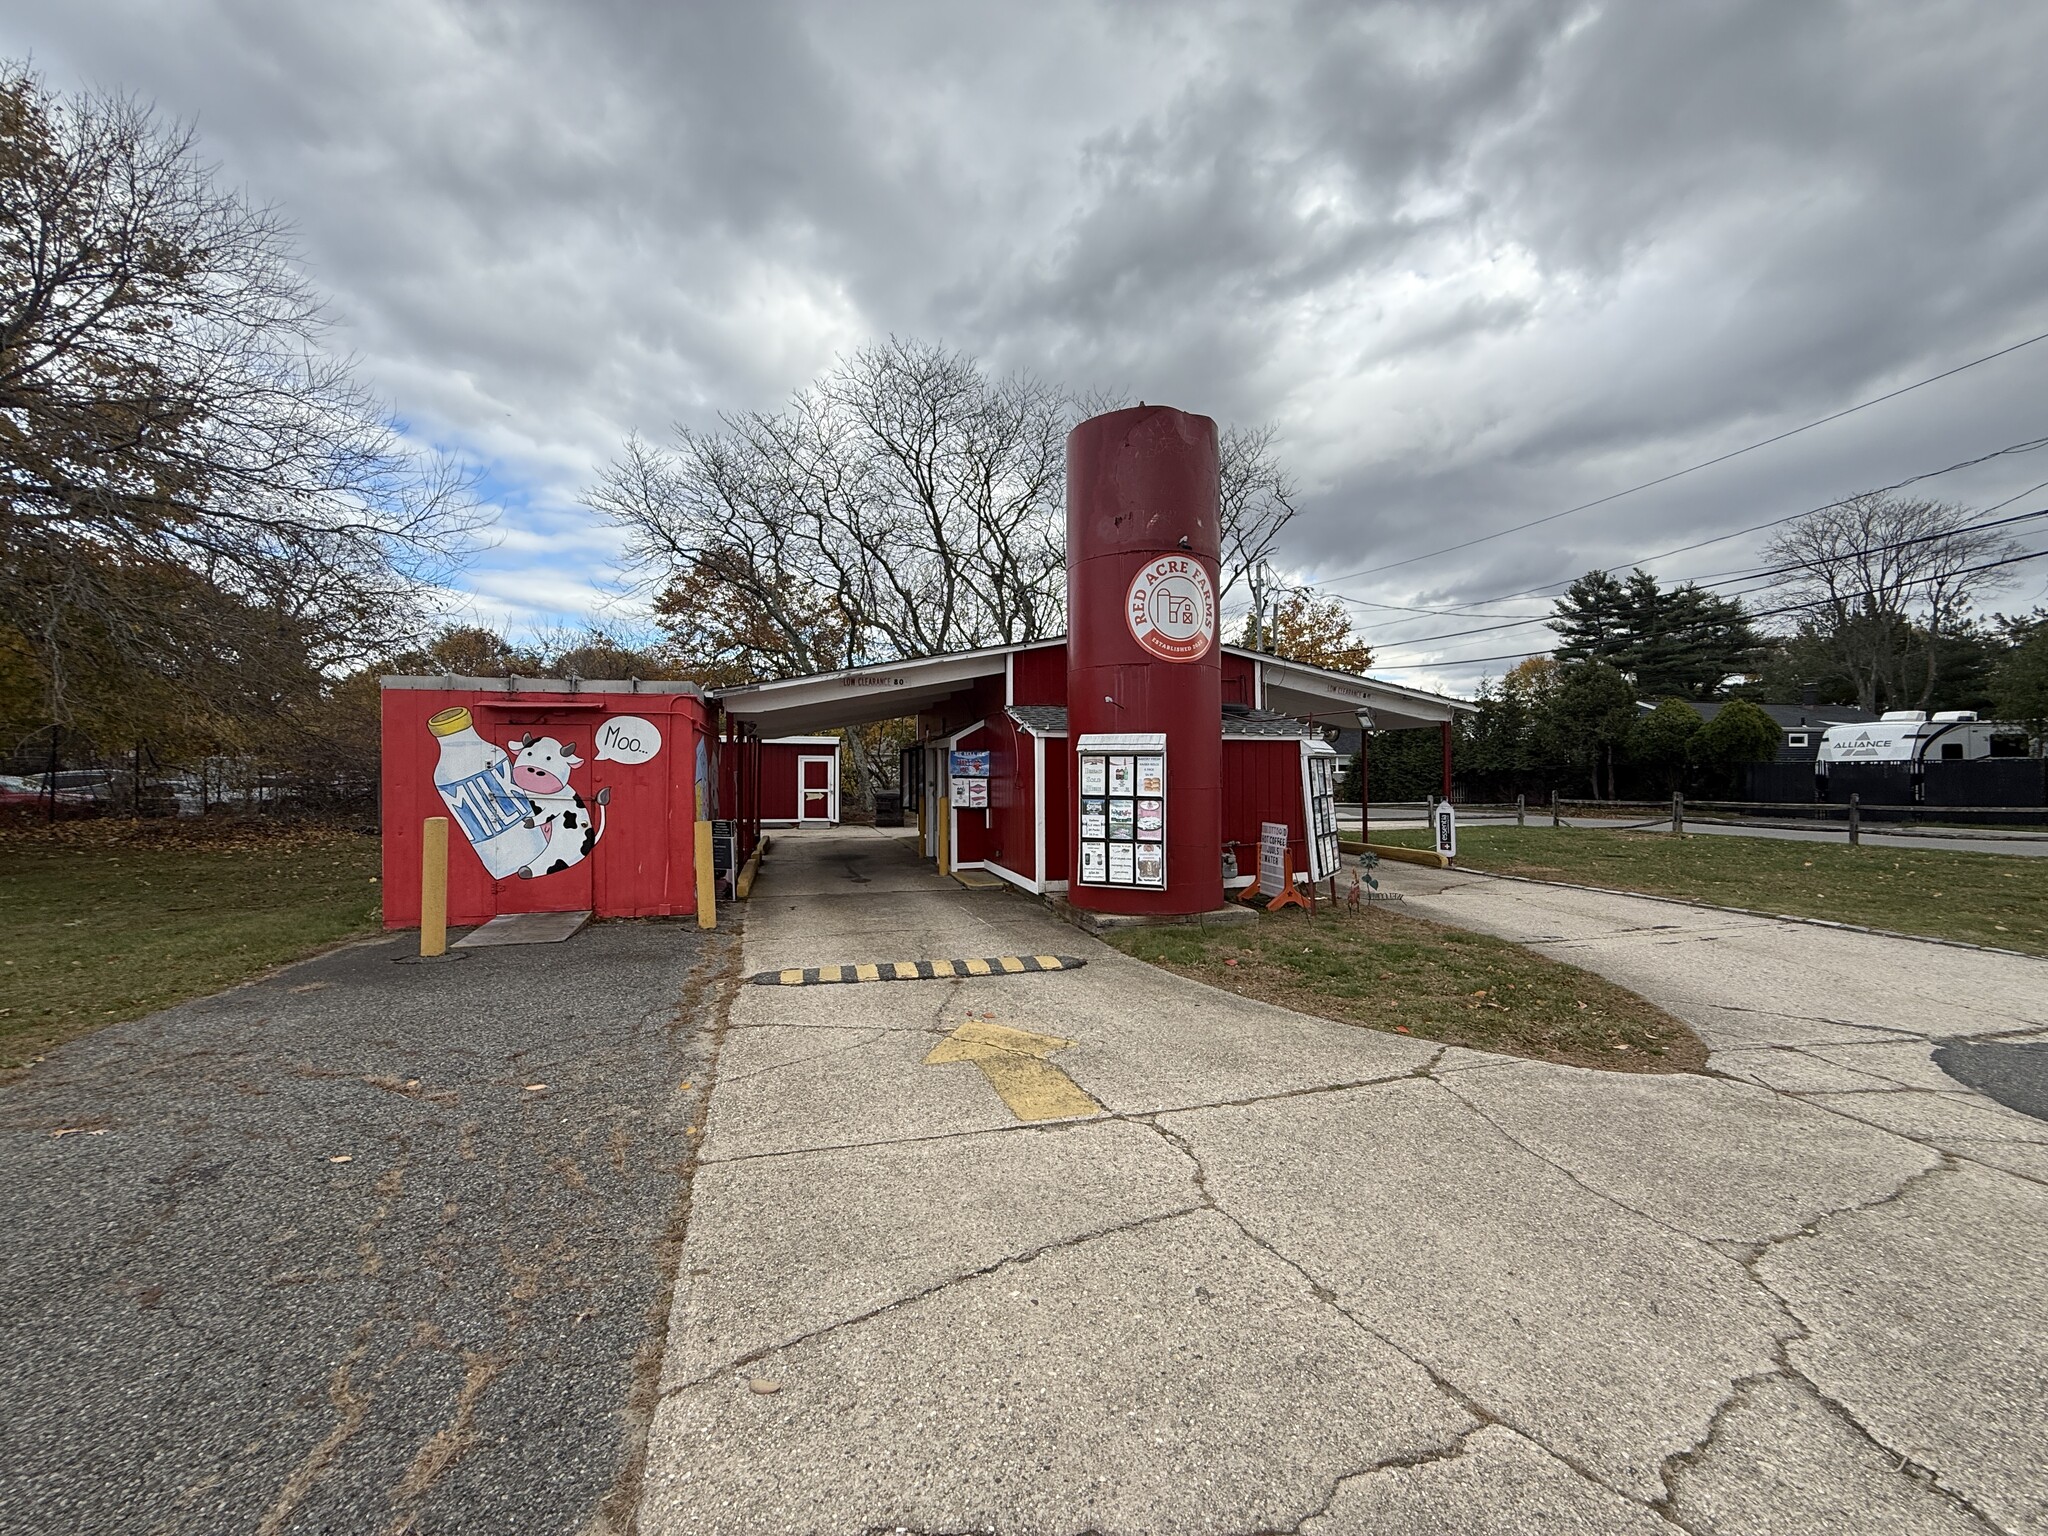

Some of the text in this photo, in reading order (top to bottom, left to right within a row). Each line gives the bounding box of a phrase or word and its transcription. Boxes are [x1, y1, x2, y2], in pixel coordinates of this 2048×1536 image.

[1133, 561, 1214, 629] RED ACRE FARMS
[1151, 637, 1192, 652] ESTABLISHED
[843, 679, 856, 687] LOW
[857, 677, 891, 687] CLEARANCE
[604, 725, 648, 754] Moo...
[1834, 740, 1892, 749] ALLIANCE
[444, 759, 530, 842] MILK
[1269, 836, 1286, 847] COFFEE
[1264, 855, 1279, 865] WATER
